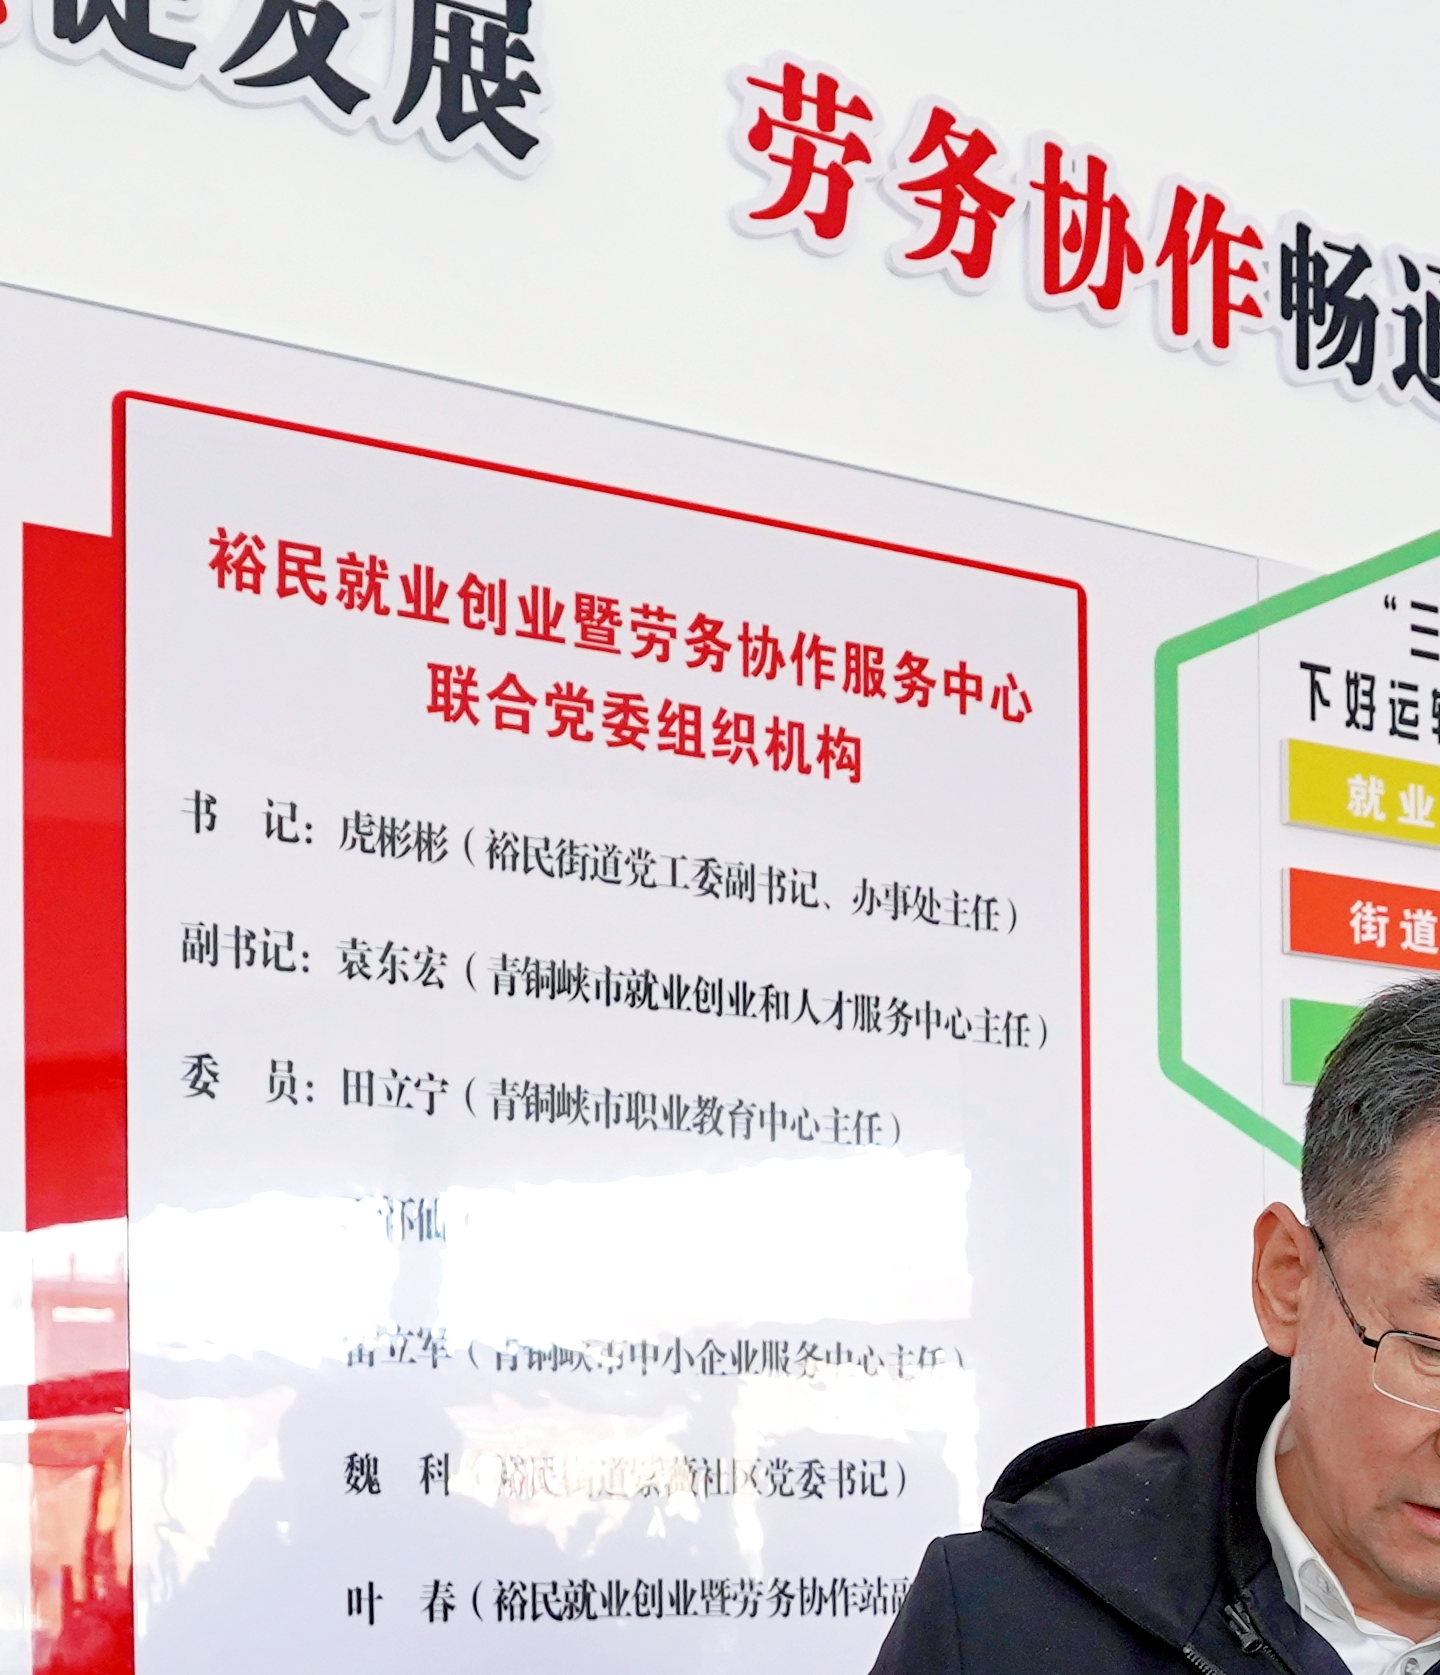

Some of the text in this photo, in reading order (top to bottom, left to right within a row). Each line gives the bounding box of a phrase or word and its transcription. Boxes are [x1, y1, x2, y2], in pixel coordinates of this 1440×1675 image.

[208, 527, 1034, 725] 裕民就业创业暨劳务协作服务中心
[426, 660, 864, 784] 联合党委组织机构
[180, 788, 218, 834] 书
[180, 1053, 220, 1102] 委
[344, 1452, 381, 1496] 魏
[345, 1581, 383, 1625] 叶
